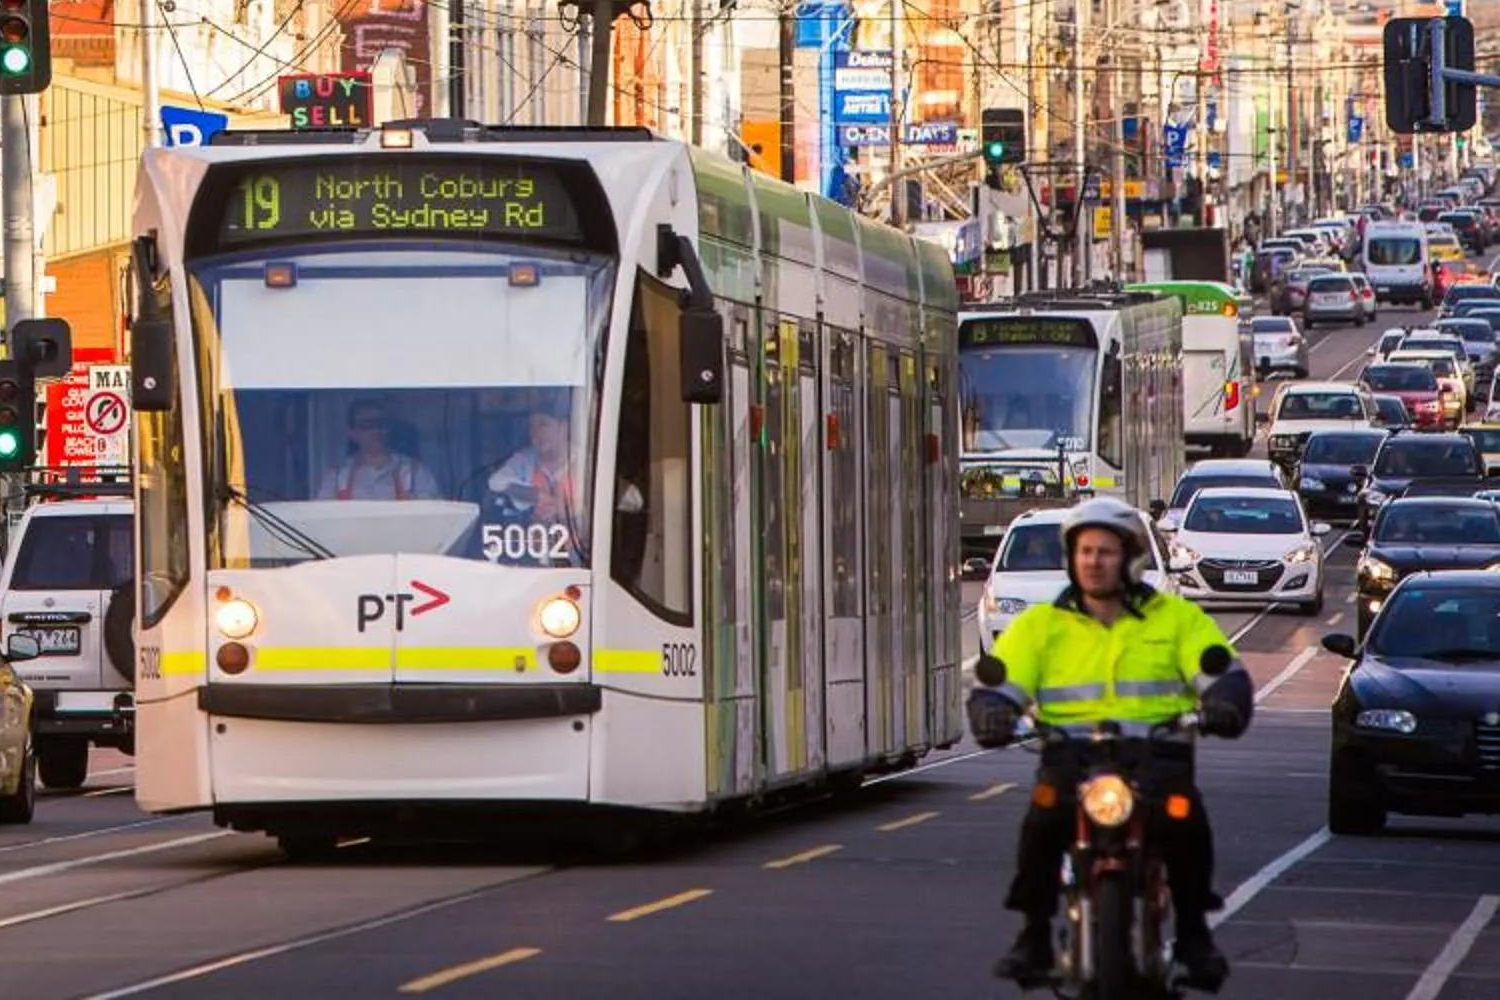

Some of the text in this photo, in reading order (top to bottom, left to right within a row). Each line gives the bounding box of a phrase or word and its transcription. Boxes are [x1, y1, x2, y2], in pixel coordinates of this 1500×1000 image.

[295, 78, 356, 99] BUY
[293, 104, 362, 127] SELL
[240, 176, 280, 230] 19
[315, 173, 403, 200] North
[309, 201, 544, 229] via Sydney Rd
[483, 523, 570, 559] 5002
[663, 643, 696, 677] 5002
